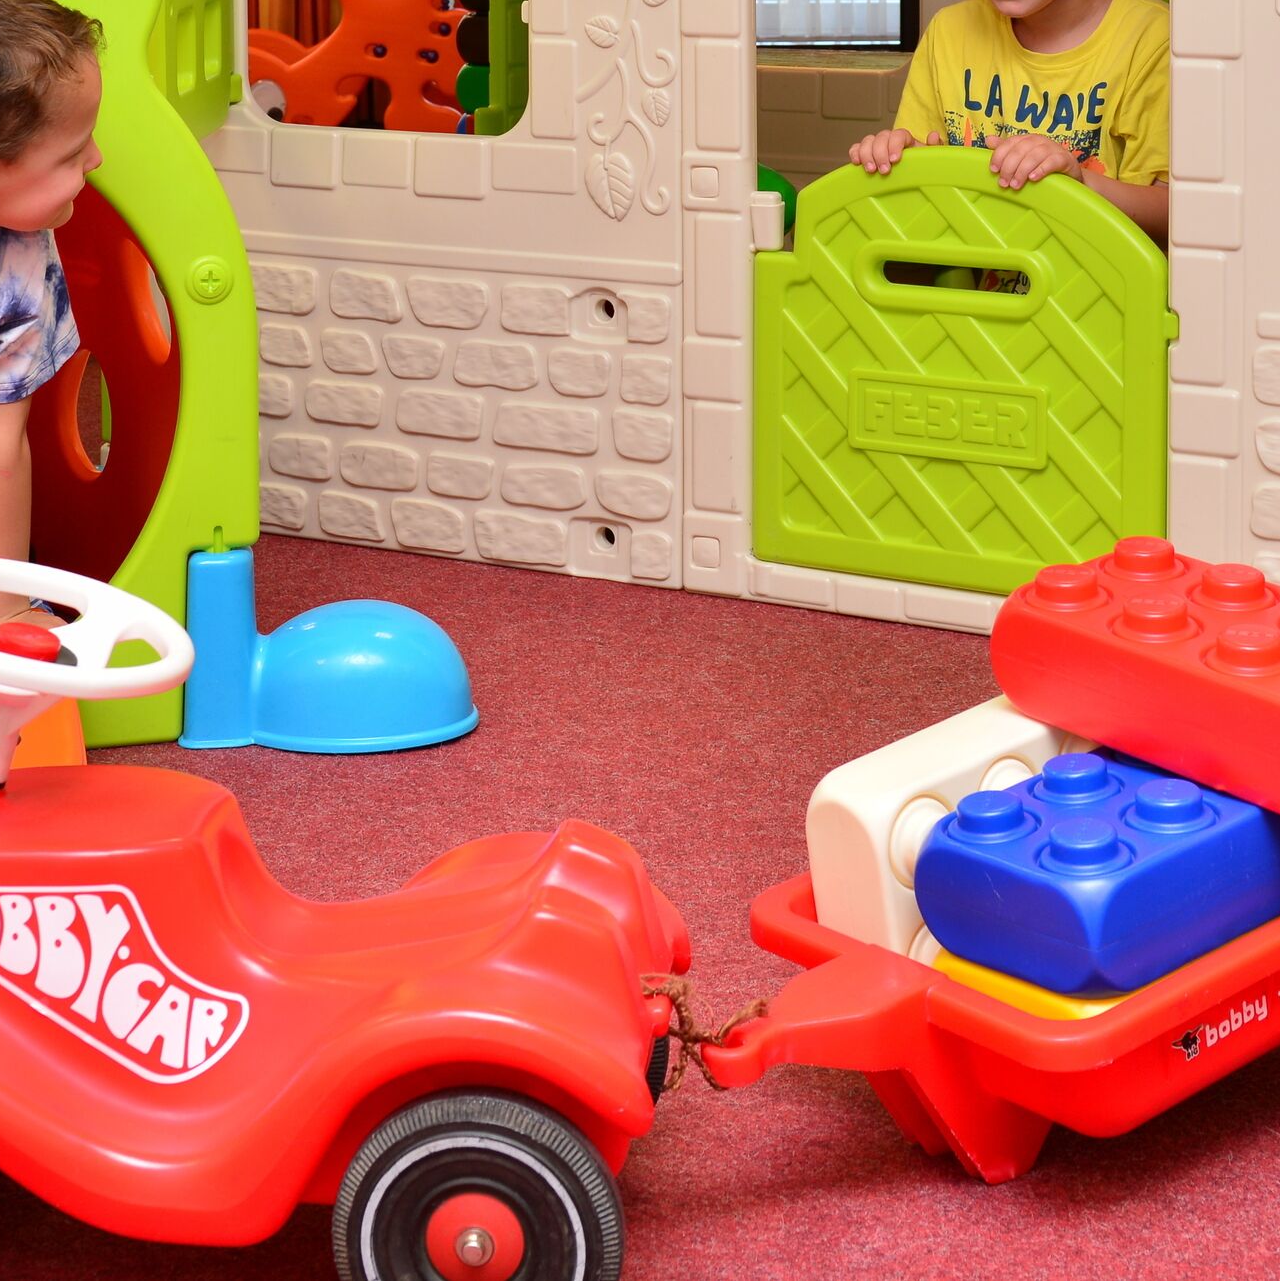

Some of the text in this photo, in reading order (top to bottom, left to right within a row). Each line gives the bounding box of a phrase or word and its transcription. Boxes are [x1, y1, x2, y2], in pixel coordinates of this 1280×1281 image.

[963, 68, 1004, 119] LA
[863, 387, 1028, 450] FEBER
[1204, 995, 1269, 1048] bobby
